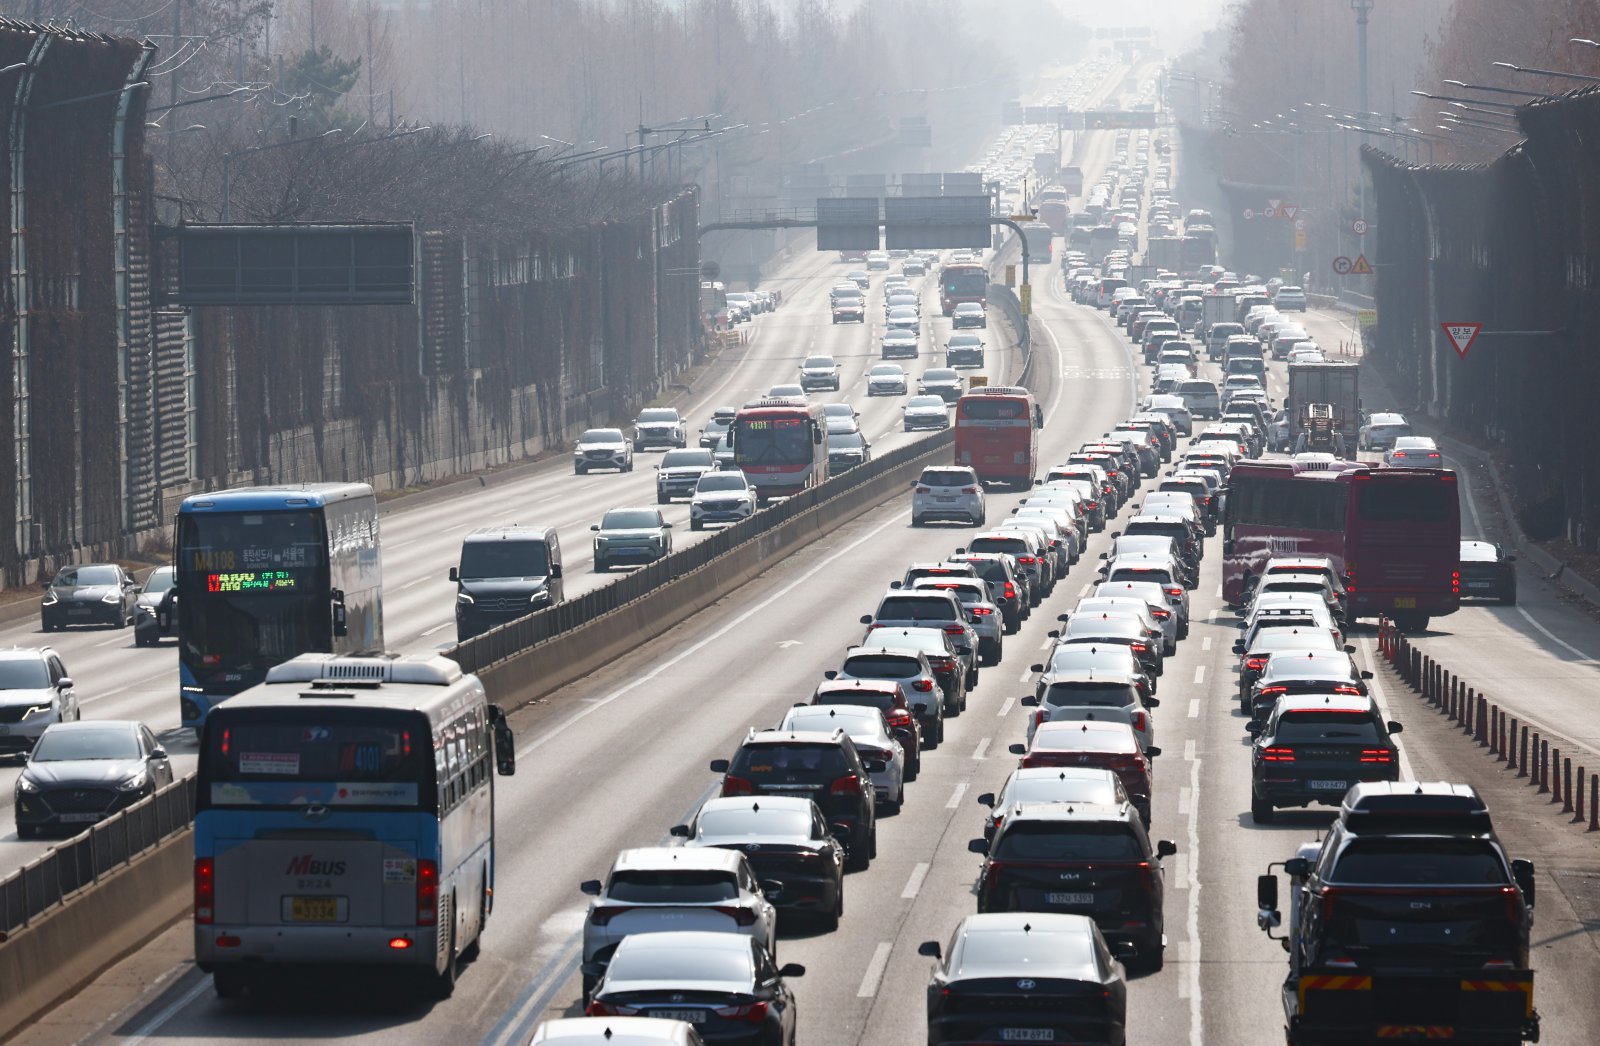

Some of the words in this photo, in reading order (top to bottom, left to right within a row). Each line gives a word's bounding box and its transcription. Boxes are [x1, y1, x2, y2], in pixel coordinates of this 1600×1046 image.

[194, 550, 235, 571] M4108
[243, 548, 273, 562] 동탄신도시
[282, 547, 305, 561] 서울역
[286, 855, 346, 875] MBUS
